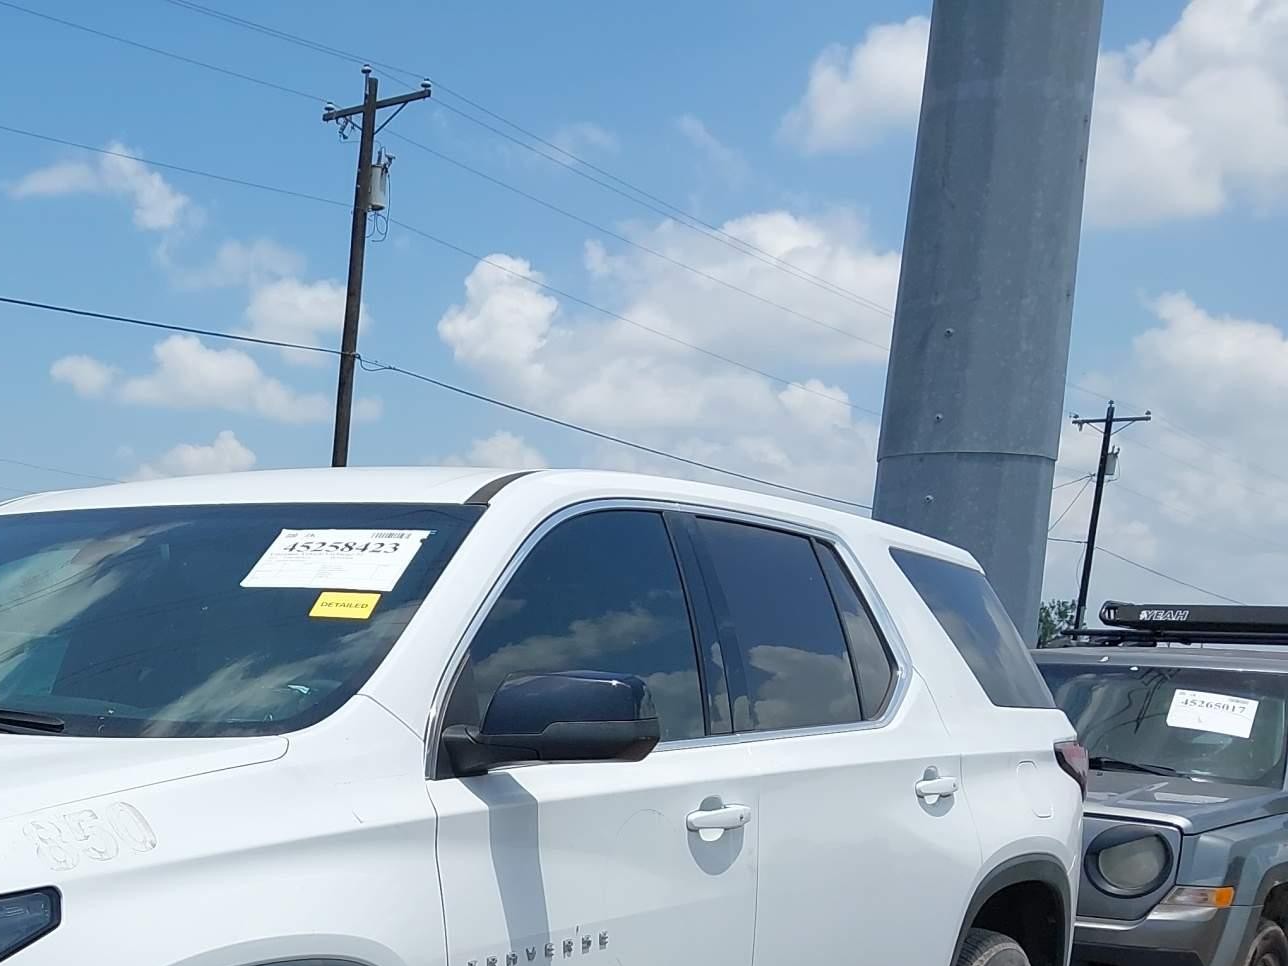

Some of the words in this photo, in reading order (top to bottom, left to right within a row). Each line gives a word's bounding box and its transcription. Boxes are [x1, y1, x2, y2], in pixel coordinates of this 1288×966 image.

[283, 541, 400, 554] 45258423
[320, 601, 369, 609] DETAILED
[1182, 698, 1247, 714] 45265017
